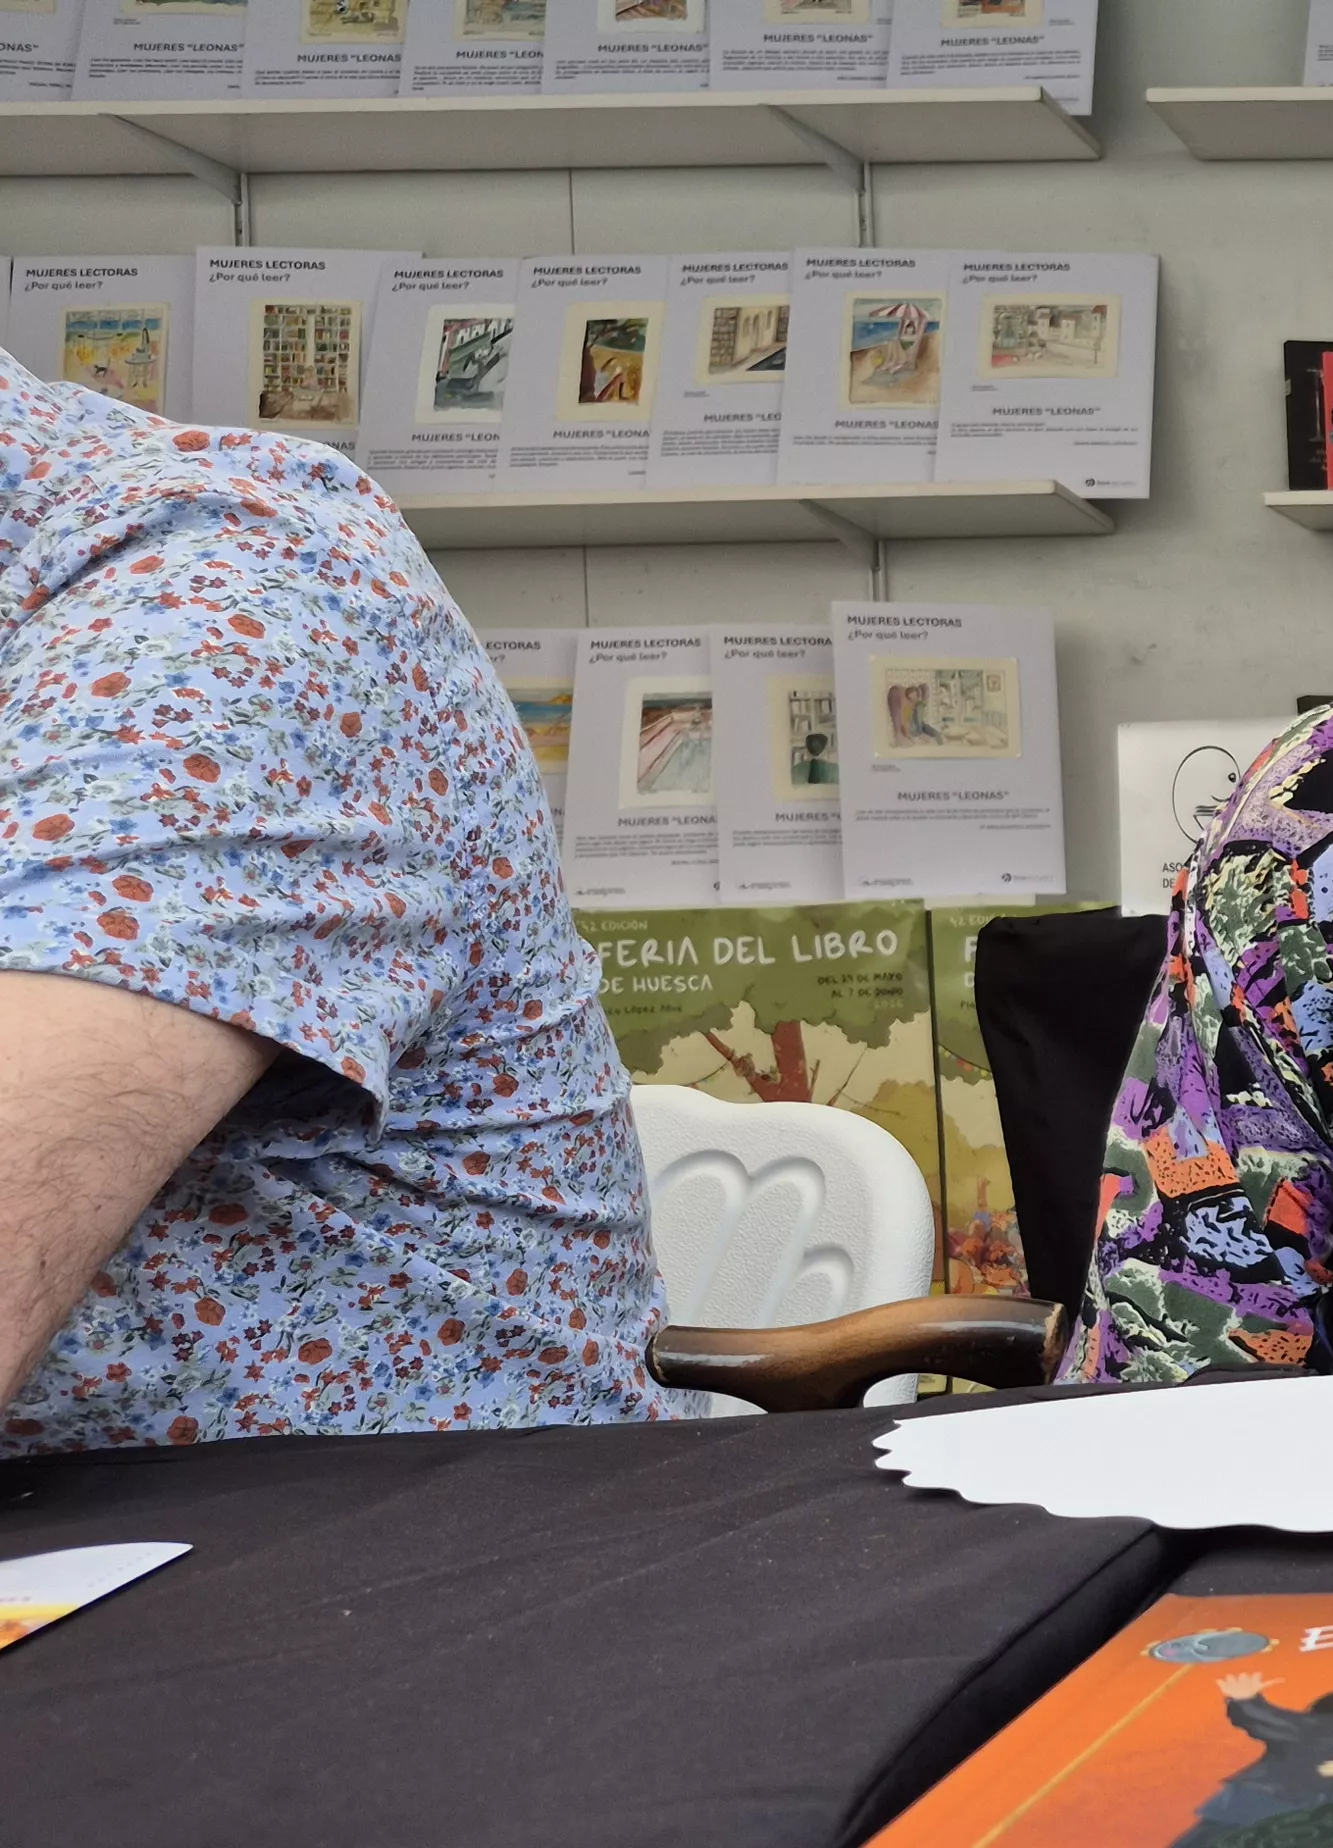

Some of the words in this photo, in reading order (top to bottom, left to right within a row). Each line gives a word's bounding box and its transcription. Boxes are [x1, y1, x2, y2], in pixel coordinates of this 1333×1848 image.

[764, 34, 814, 43] MUJERES
[941, 38, 989, 46] MUJERES
[134, 43, 185, 52] MUJERES
[598, 44, 650, 53] MUJERES
[297, 54, 349, 63] MUJERES
[456, 51, 507, 60] MUJERES
[210, 259, 263, 269] MUJERES
[265, 261, 326, 271] LECTORAS
[806, 259, 856, 267] MUJERES
[859, 259, 915, 268] LECTORAS
[26, 268, 76, 277] MUJERES
[80, 268, 138, 277] LECTORAS
[394, 270, 445, 278] MUJERES
[447, 270, 504, 278] LECTORAS
[533, 266, 583, 275] MUJERES
[585, 266, 641, 275] LECTORAS
[209, 273, 235, 283] ¿Por
[237, 272, 259, 284] qué
[262, 273, 291, 282] leer?
[24, 281, 50, 291] ¿Por
[52, 280, 72, 291] qué
[75, 281, 103, 290] leer?
[993, 407, 1042, 416] MUJERES
[704, 414, 753, 422] MUJERES
[835, 420, 886, 429] MUJERES
[412, 434, 463, 442] MUJERES
[553, 430, 604, 438] MUJERES
[847, 616, 900, 626] MUJERES
[903, 617, 962, 627] LECTORAS
[848, 630, 873, 640] ¿Por
[875, 630, 897, 641] qué
[899, 630, 928, 640] leer?
[590, 640, 641, 649] MUJERES
[644, 638, 701, 648] LECTORAS
[724, 636, 775, 646] MUJERES
[589, 653, 614, 664] ¿Por
[616, 652, 637, 663] qué
[639, 651, 667, 661] leer?
[898, 791, 950, 800] MUJERES
[618, 817, 669, 827] MUJERES
[775, 813, 829, 823] MUJERES
[598, 936, 698, 967] FERIA
[714, 936, 776, 967] DEL
[792, 929, 898, 963] LIBRO
[633, 974, 713, 993] HUESCA
